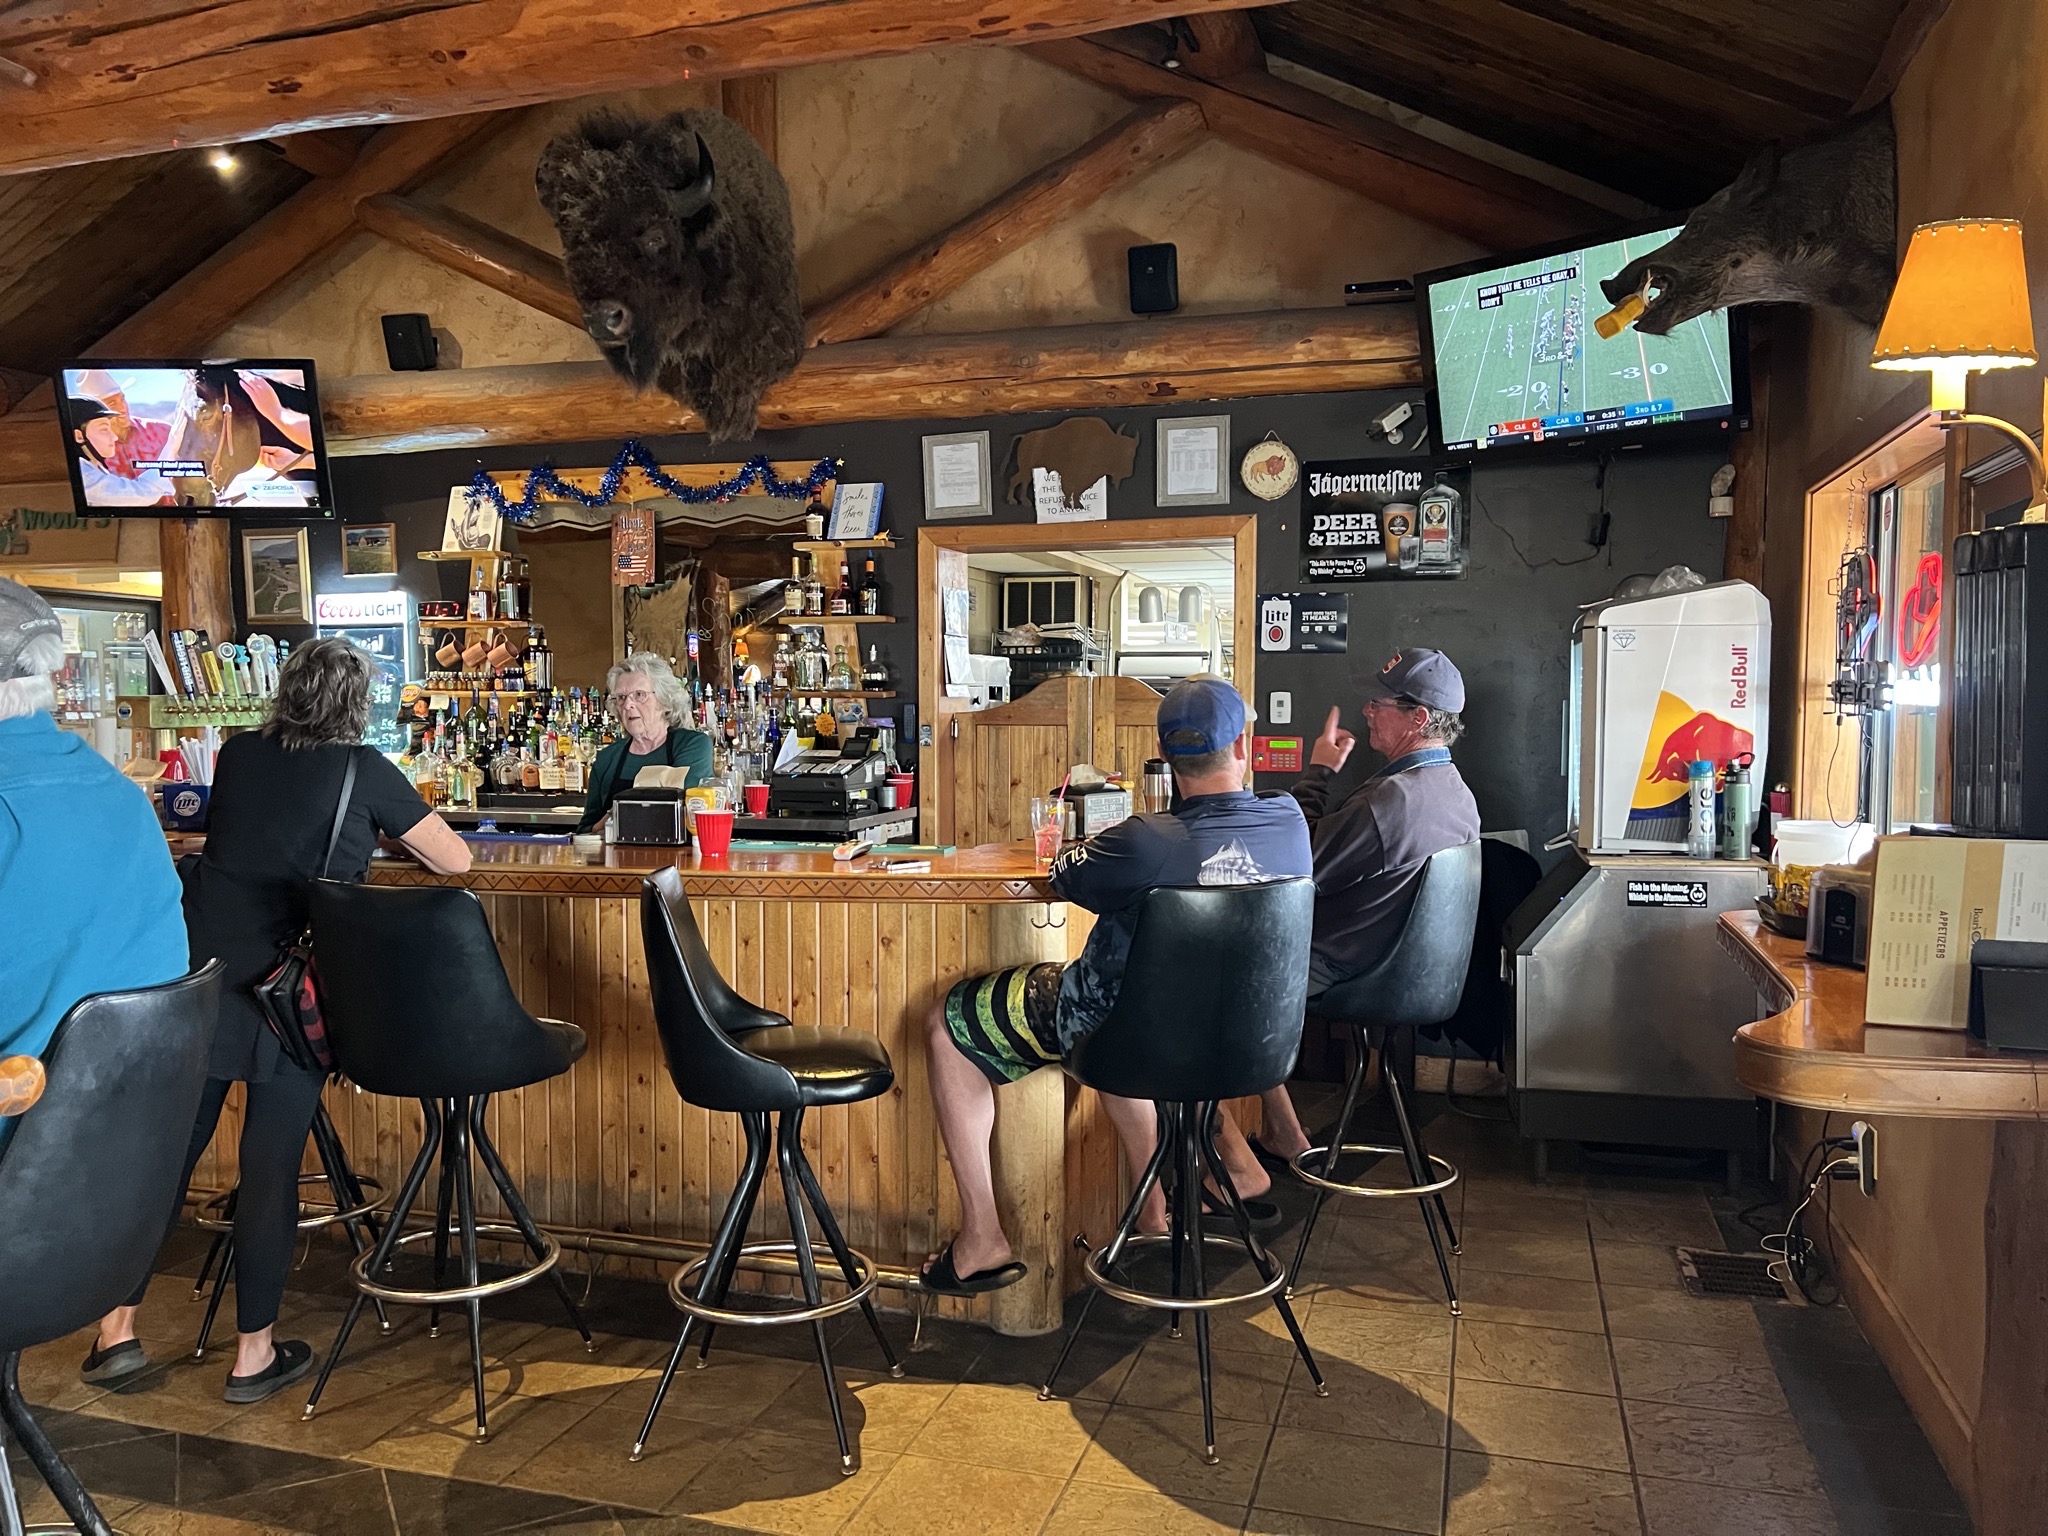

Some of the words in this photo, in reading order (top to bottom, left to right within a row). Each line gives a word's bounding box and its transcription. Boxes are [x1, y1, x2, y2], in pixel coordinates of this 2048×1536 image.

[1480, 286, 1497, 297] KNOW
[1498, 282, 1512, 293] THAT
[1513, 280, 1522, 290] HE
[1522, 277, 1541, 288] TELLS
[1541, 274, 1551, 284] ME
[1514, 423, 1526, 431] CLE
[1556, 417, 1569, 425] CAR
[1575, 415, 1581, 423] 0
[1602, 411, 1616, 420] 0:35
[1651, 404, 1657, 412] &
[1658, 403, 1663, 411] 7
[1044, 474, 1056, 482] WE
[1308, 470, 1422, 497] Jägermeister
[1042, 485, 1057, 493] THE
[1047, 507, 1058, 515] TO
[1313, 513, 1377, 531] DEER
[1308, 533, 1324, 547] &
[1325, 531, 1380, 546] BEER
[319, 599, 361, 618] Coors
[364, 603, 403, 616] LIGHT
[1265, 609, 1289, 625] Lite
[1732, 647, 1748, 677] Bull
[1731, 679, 1746, 709] Red
[177, 797, 199, 810] Lite
[1700, 788, 1713, 833] core
[1629, 882, 1642, 891] Fish
[1643, 883, 1650, 892] in
[1650, 883, 1661, 892] the
[1628, 892, 1649, 903] Whiskey
[1649, 893, 1655, 901] in
[1654, 893, 1664, 902] the
[1935, 910, 1949, 959] APPETIZERS
